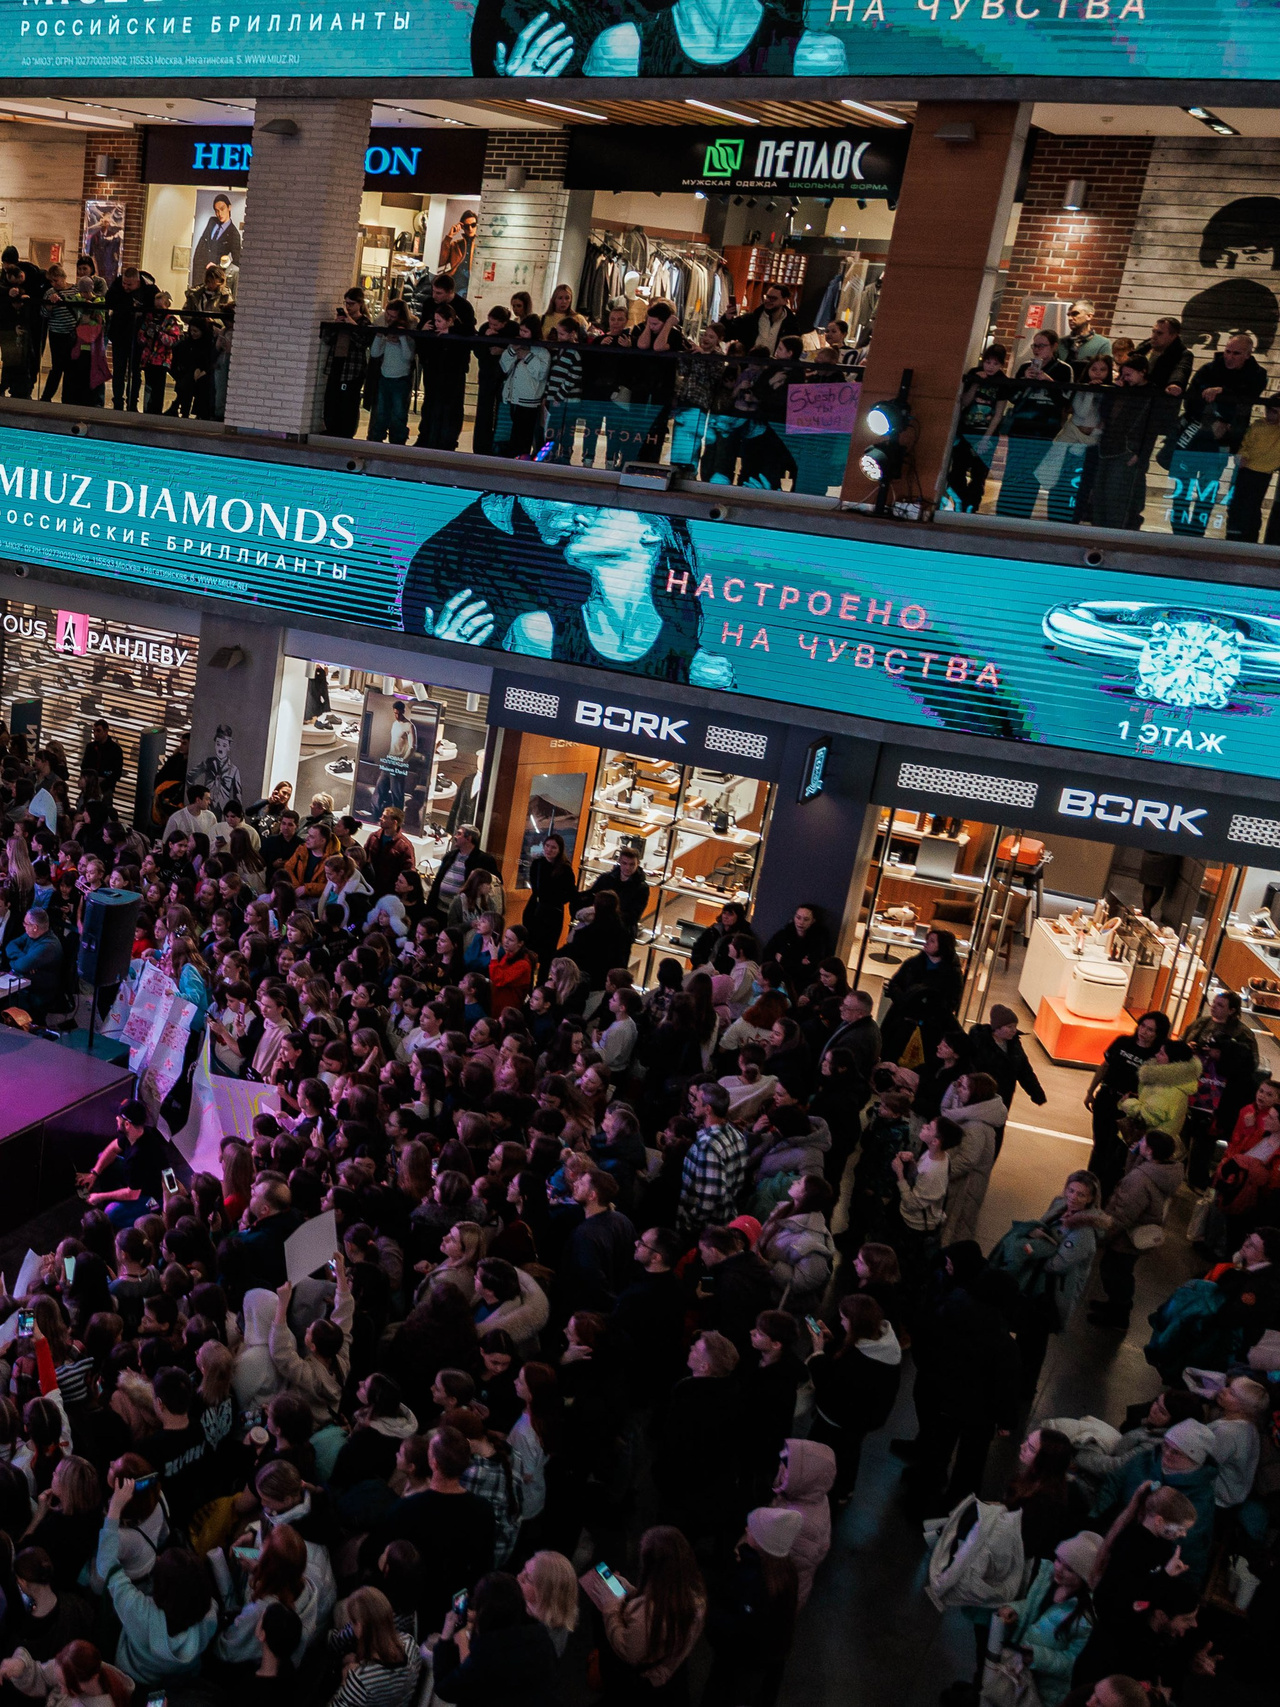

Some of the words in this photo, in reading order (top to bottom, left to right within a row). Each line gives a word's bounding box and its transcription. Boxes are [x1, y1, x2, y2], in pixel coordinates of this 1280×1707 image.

[20, 15, 193, 36] РОССИЙСКИЕ
[210, 11, 411, 33] БРИЛЛИАНТЫ
[754, 140, 871, 180] ПЕПЛОС
[681, 179, 731, 188] МУЖСКАЯ
[735, 180, 778, 189] ОДЕЖДА
[788, 182, 845, 190] ШКОЛЬНАЯ
[850, 183, 889, 191] ФОРМА
[105, 479, 355, 549] DIAMONDS
[166, 535, 348, 580] БРИЛЛИАНТЫ
[666, 568, 930, 632] НАСТРОЕНО
[87, 631, 189, 667] РАНДЕВУ
[721, 621, 772, 653] НА
[798, 632, 1002, 687] ЧУВСТВА
[575, 699, 689, 745] BORK
[1118, 720, 1128, 741] 1
[1138, 724, 1227, 754] ЭТАЖ
[1058, 787, 1208, 837] BORK
